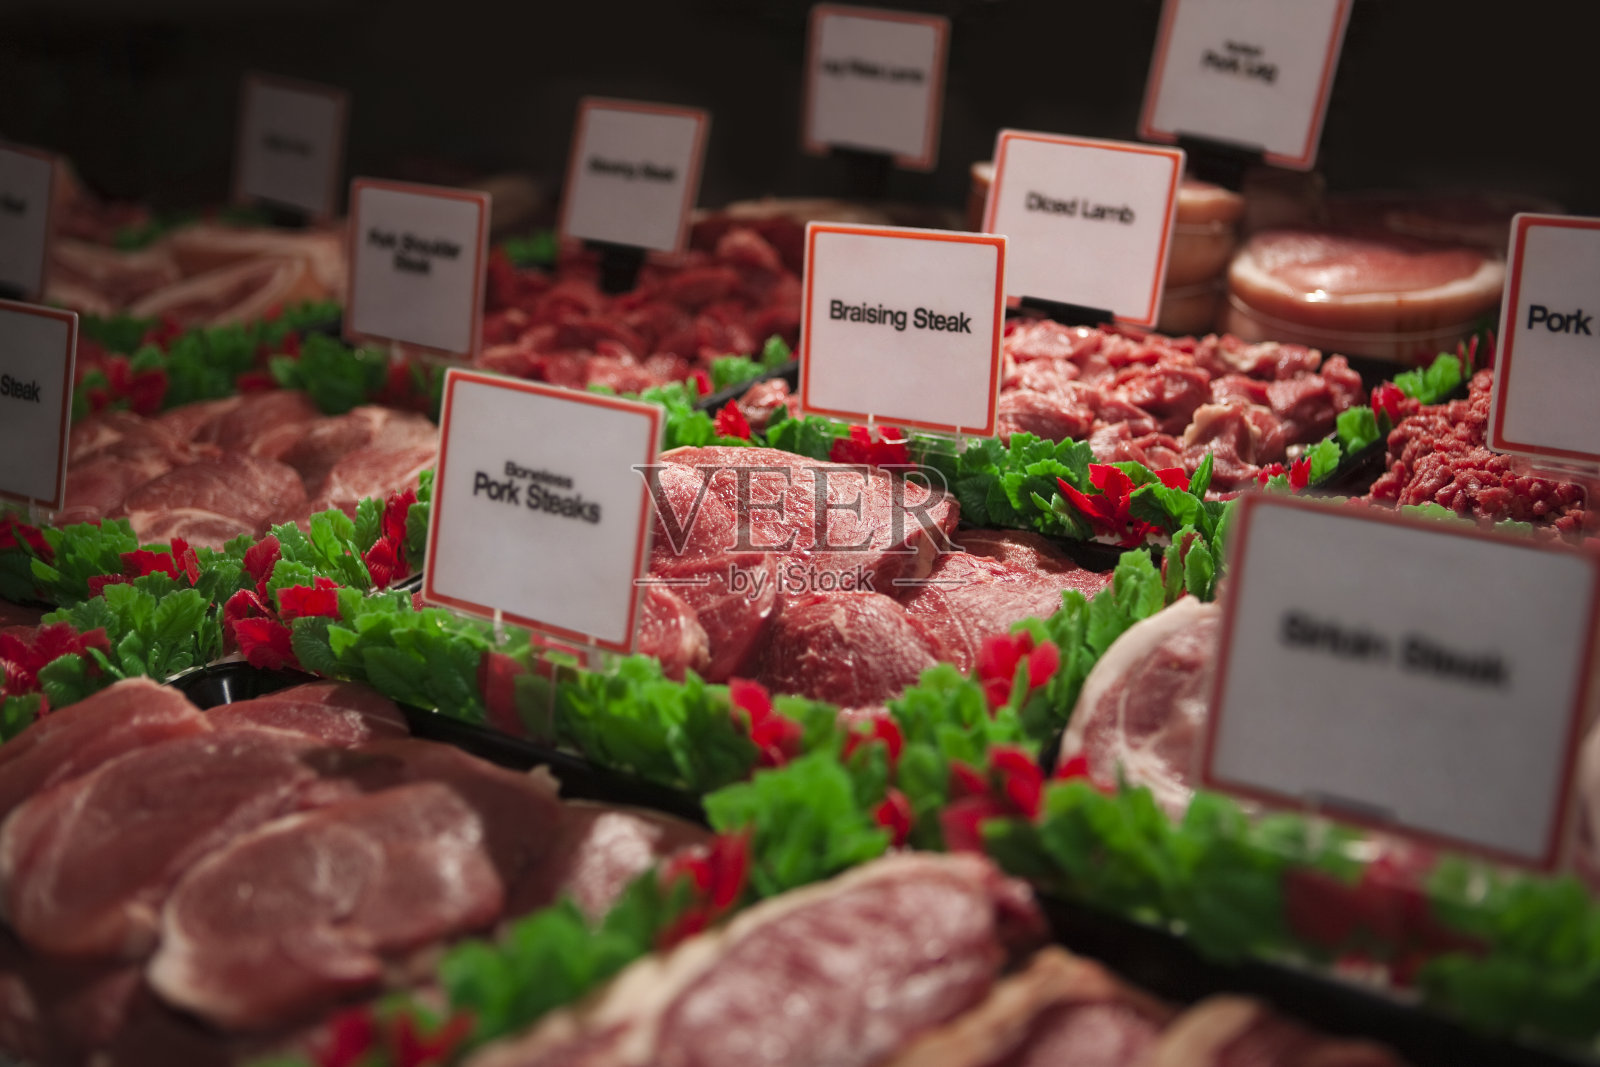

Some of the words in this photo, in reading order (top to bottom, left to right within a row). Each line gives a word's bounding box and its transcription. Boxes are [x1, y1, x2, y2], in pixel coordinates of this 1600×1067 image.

[1081, 198, 1135, 226] Lamb
[830, 299, 907, 332] Braising
[913, 307, 972, 334] Steak
[1527, 304, 1594, 336] Pork
[0, 374, 42, 404] Steak
[505, 460, 573, 489] Boneless
[473, 471, 520, 506] Pork
[526, 483, 602, 525] Steaks
